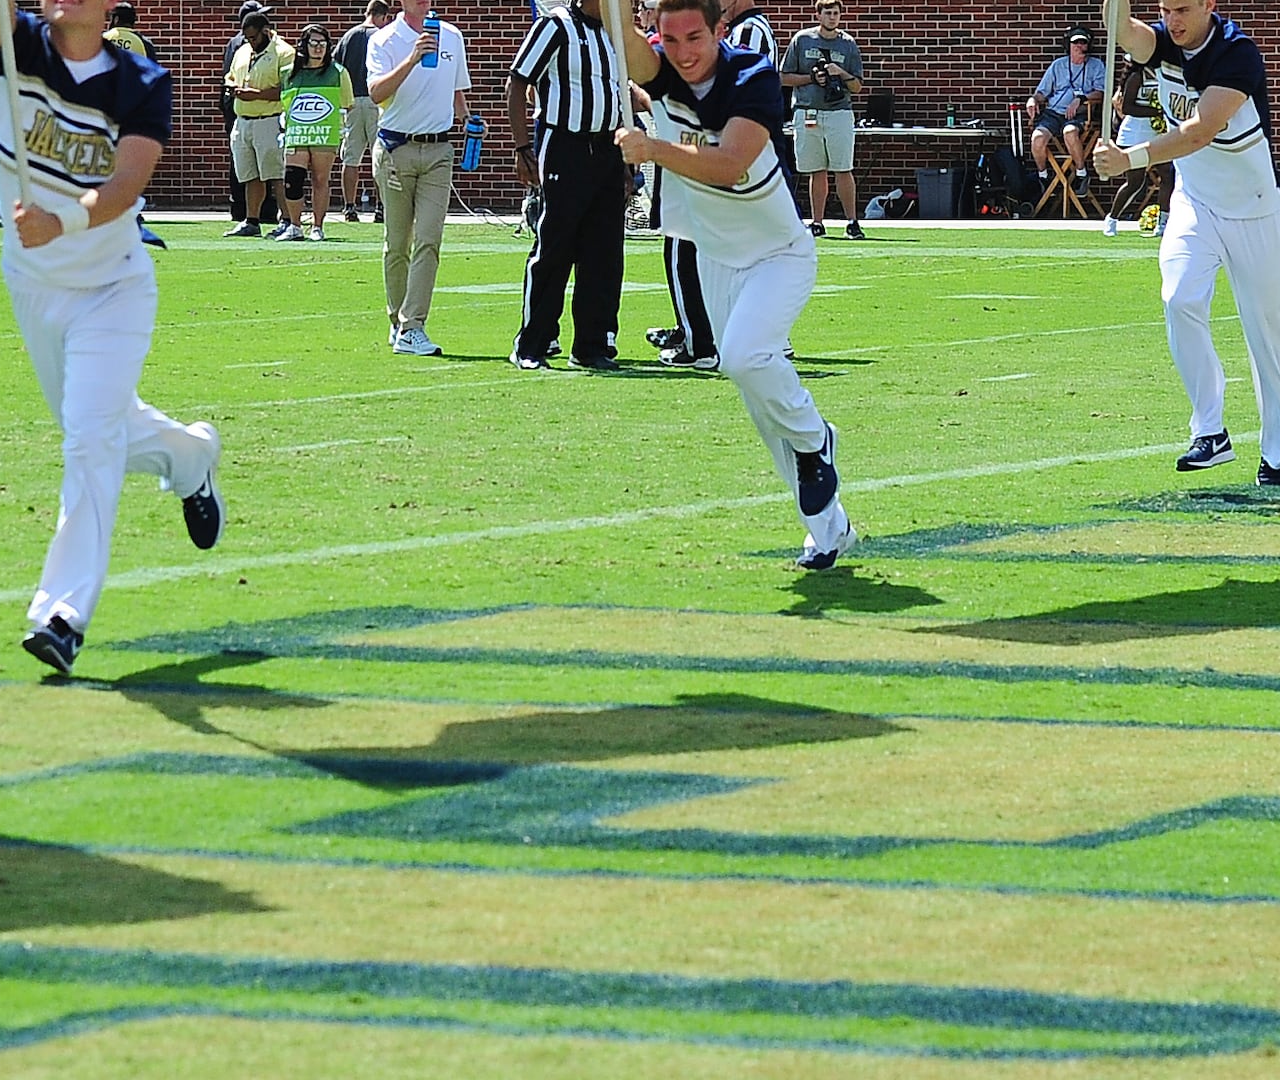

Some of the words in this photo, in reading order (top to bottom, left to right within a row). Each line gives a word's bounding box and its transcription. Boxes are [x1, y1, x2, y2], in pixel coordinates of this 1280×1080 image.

[293, 101, 324, 112] ACC
[24, 109, 116, 177] JACKETS
[287, 135, 330, 145] REPLAY
